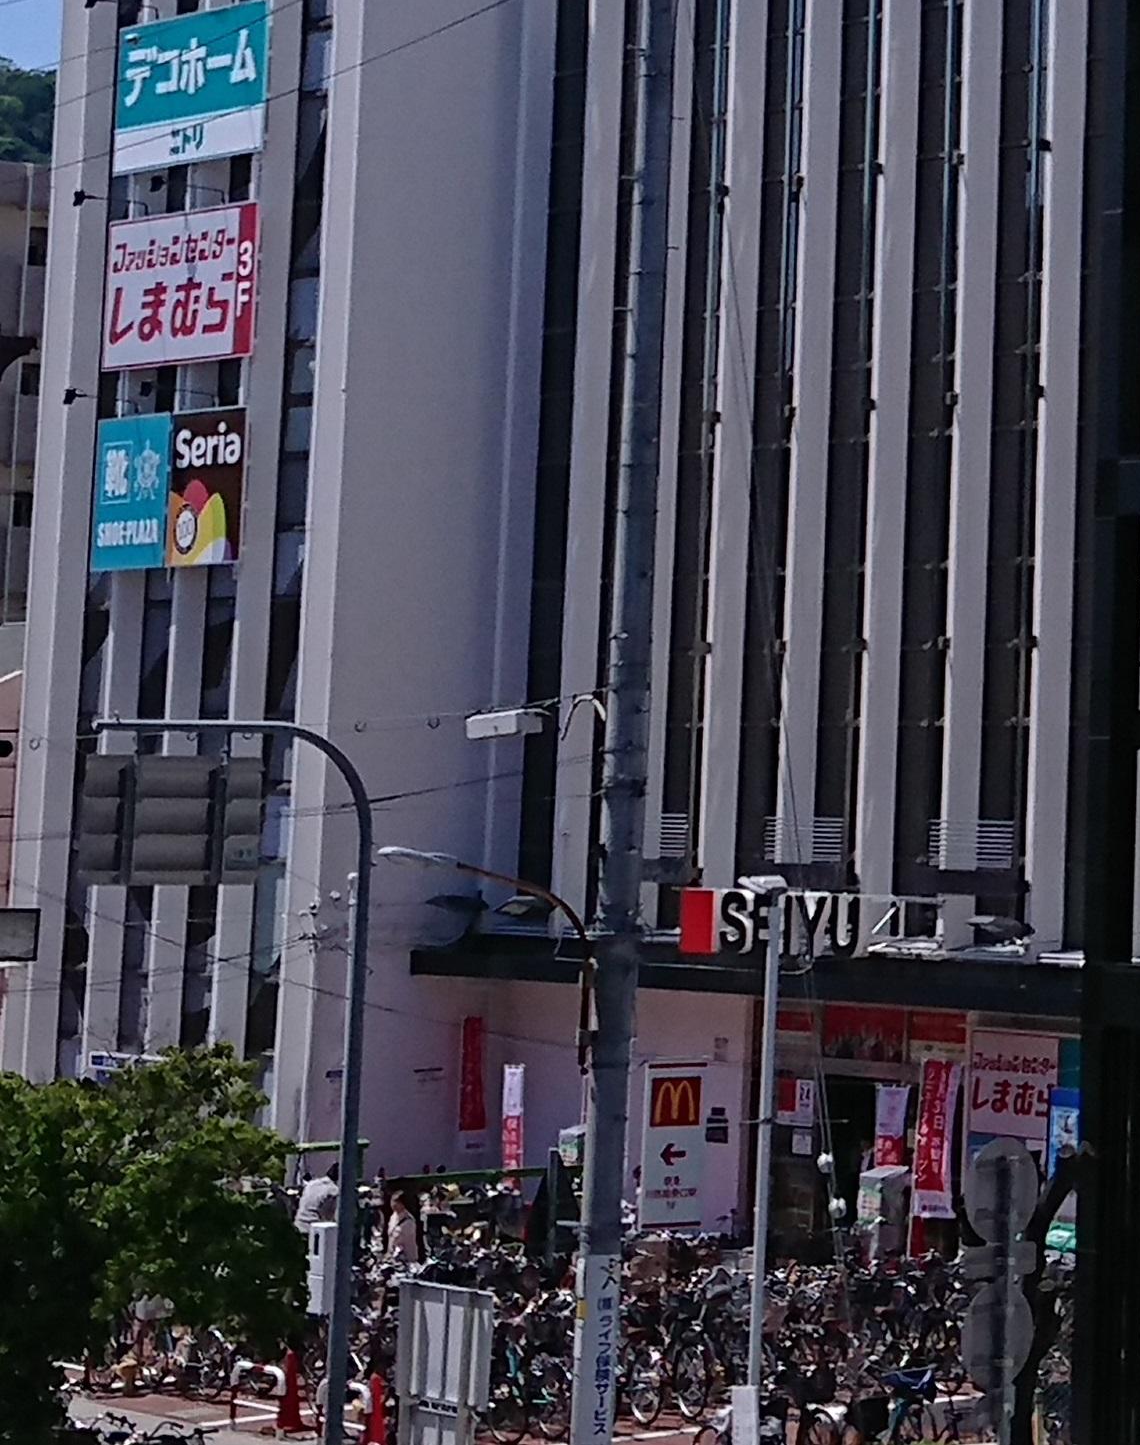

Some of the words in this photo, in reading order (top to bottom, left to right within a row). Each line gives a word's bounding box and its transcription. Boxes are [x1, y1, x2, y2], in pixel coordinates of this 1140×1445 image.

[123, 27, 257, 107] デコホーム
[169, 122, 205, 155] ニトリ
[112, 228, 236, 274] ファッションセンター
[109, 271, 234, 345] しまむら
[175, 420, 242, 469] Seria
